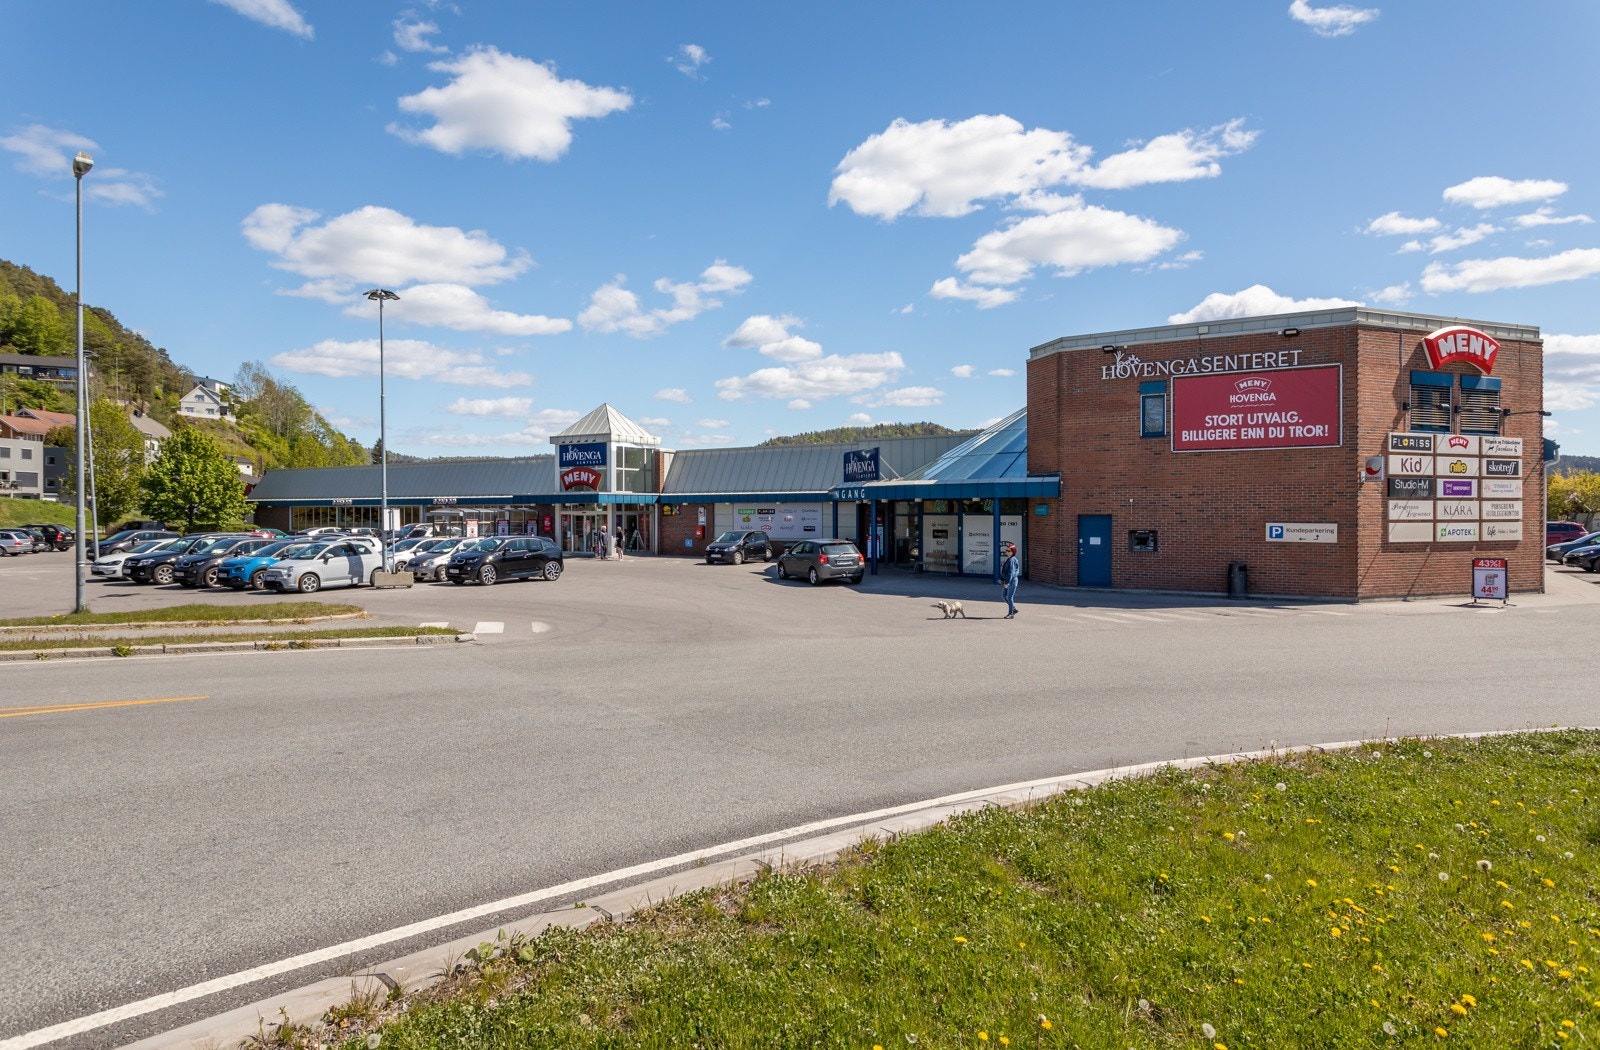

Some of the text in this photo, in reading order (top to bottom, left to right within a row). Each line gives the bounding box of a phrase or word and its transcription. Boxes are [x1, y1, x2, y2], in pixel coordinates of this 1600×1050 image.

[1437, 333, 1497, 360] MENY
[1239, 379, 1268, 389] MENY
[1229, 392, 1277, 403] HOVENGA
[1205, 411, 1303, 427] STORT UTVALG.
[1181, 424, 1329, 442] BILLIGERE ENN DU TROR!
[1392, 437, 1431, 448] FLORISS
[1450, 438, 1468, 447] MENY
[562, 450, 602, 461] HOVENGA
[845, 460, 876, 475] HOVENGA
[1400, 457, 1422, 473] Kid
[1449, 460, 1467, 474] nille
[1488, 461, 1517, 475] skotreff
[563, 471, 596, 485] MENY
[1443, 505, 1473, 516] KLARA
[1272, 526, 1282, 538] P
[1447, 528, 1477, 536] APOTEK 1
